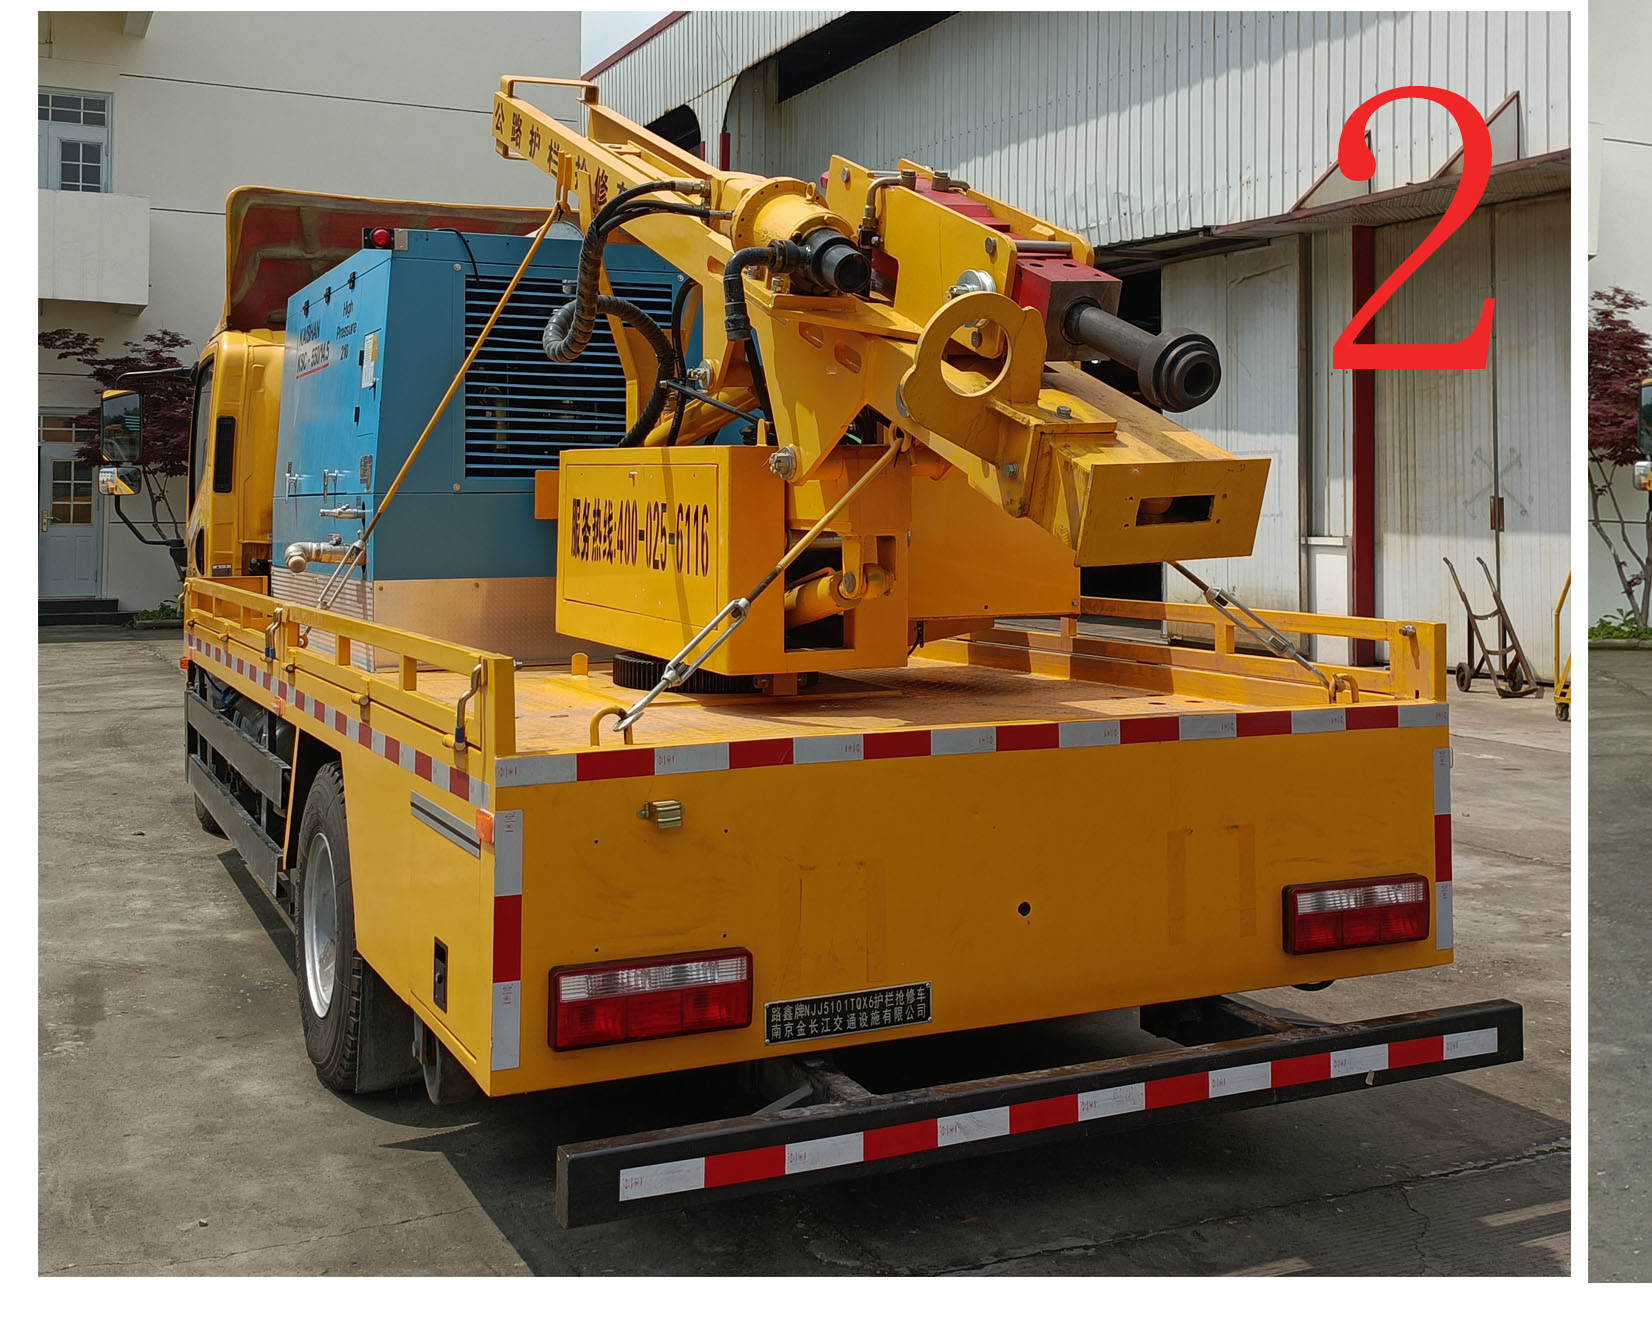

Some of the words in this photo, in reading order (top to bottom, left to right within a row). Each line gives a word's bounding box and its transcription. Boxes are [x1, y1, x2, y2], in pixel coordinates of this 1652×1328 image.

[342, 299, 354, 319] High
[336, 321, 358, 341] Pressure
[771, 986, 927, 1022] 路鑫牌NJJ5101TQX6护栏抢修车
[771, 1003, 927, 1040] 南京金长江交通设施有限公司
